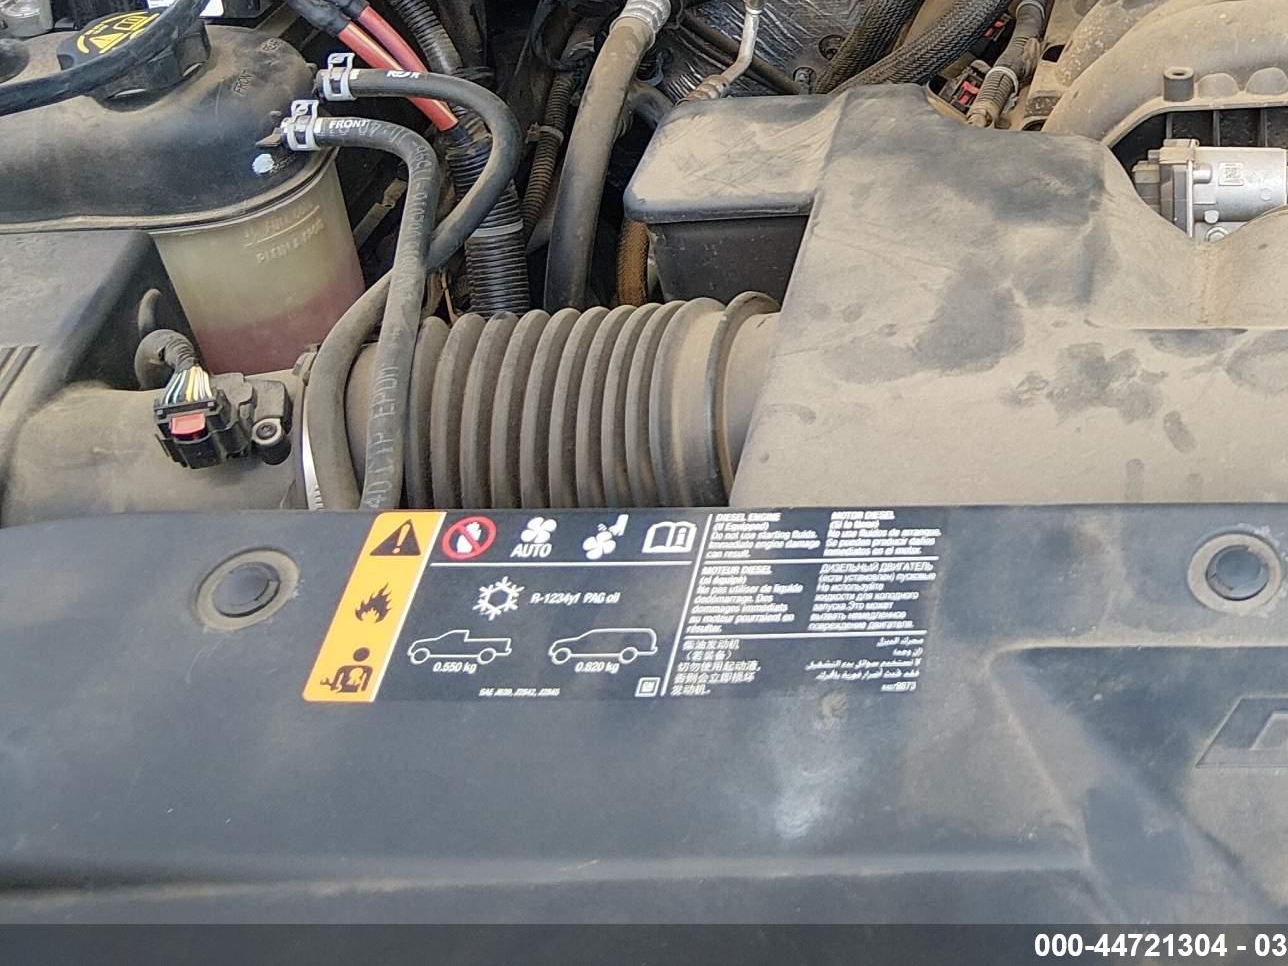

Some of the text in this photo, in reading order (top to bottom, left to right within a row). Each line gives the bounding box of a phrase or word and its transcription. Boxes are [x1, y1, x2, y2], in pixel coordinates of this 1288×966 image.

[329, 119, 368, 129] FRONT
[715, 512, 781, 522] DIESEL ENGINE
[831, 510, 895, 520] MOTOR DIESEL
[725, 522, 770, 532] Equipped)
[710, 530, 818, 540] Do not use starting fluids.
[827, 530, 840, 538] No
[840, 530, 858, 538] use
[888, 528, 900, 537] de
[708, 540, 820, 550] Immediate engine damage
[825, 538, 838, 546] Se
[838, 538, 872, 548] pueden
[872, 536, 908, 547] producir
[510, 544, 552, 558] AUTO
[705, 550, 751, 559] can result.
[700, 566, 772, 576] MOTEUR DIESEL
[820, 562, 934, 574] ДИЗЕЛЬНЫЙ ДВИГАТЕЛЬ
[696, 586, 710, 594] Ne
[710, 586, 728, 595] pas
[728, 584, 758, 594] utiliser
[759, 584, 772, 594] de
[530, 592, 621, 606] R-1234yf PAG oil
[755, 594, 774, 603] Des
[691, 604, 741, 614] dommages
[702, 614, 734, 624] moteur
[734, 614, 782, 624] pourraient
[432, 662, 478, 674] 0.550 kg
[605, 662, 620, 674] kg
